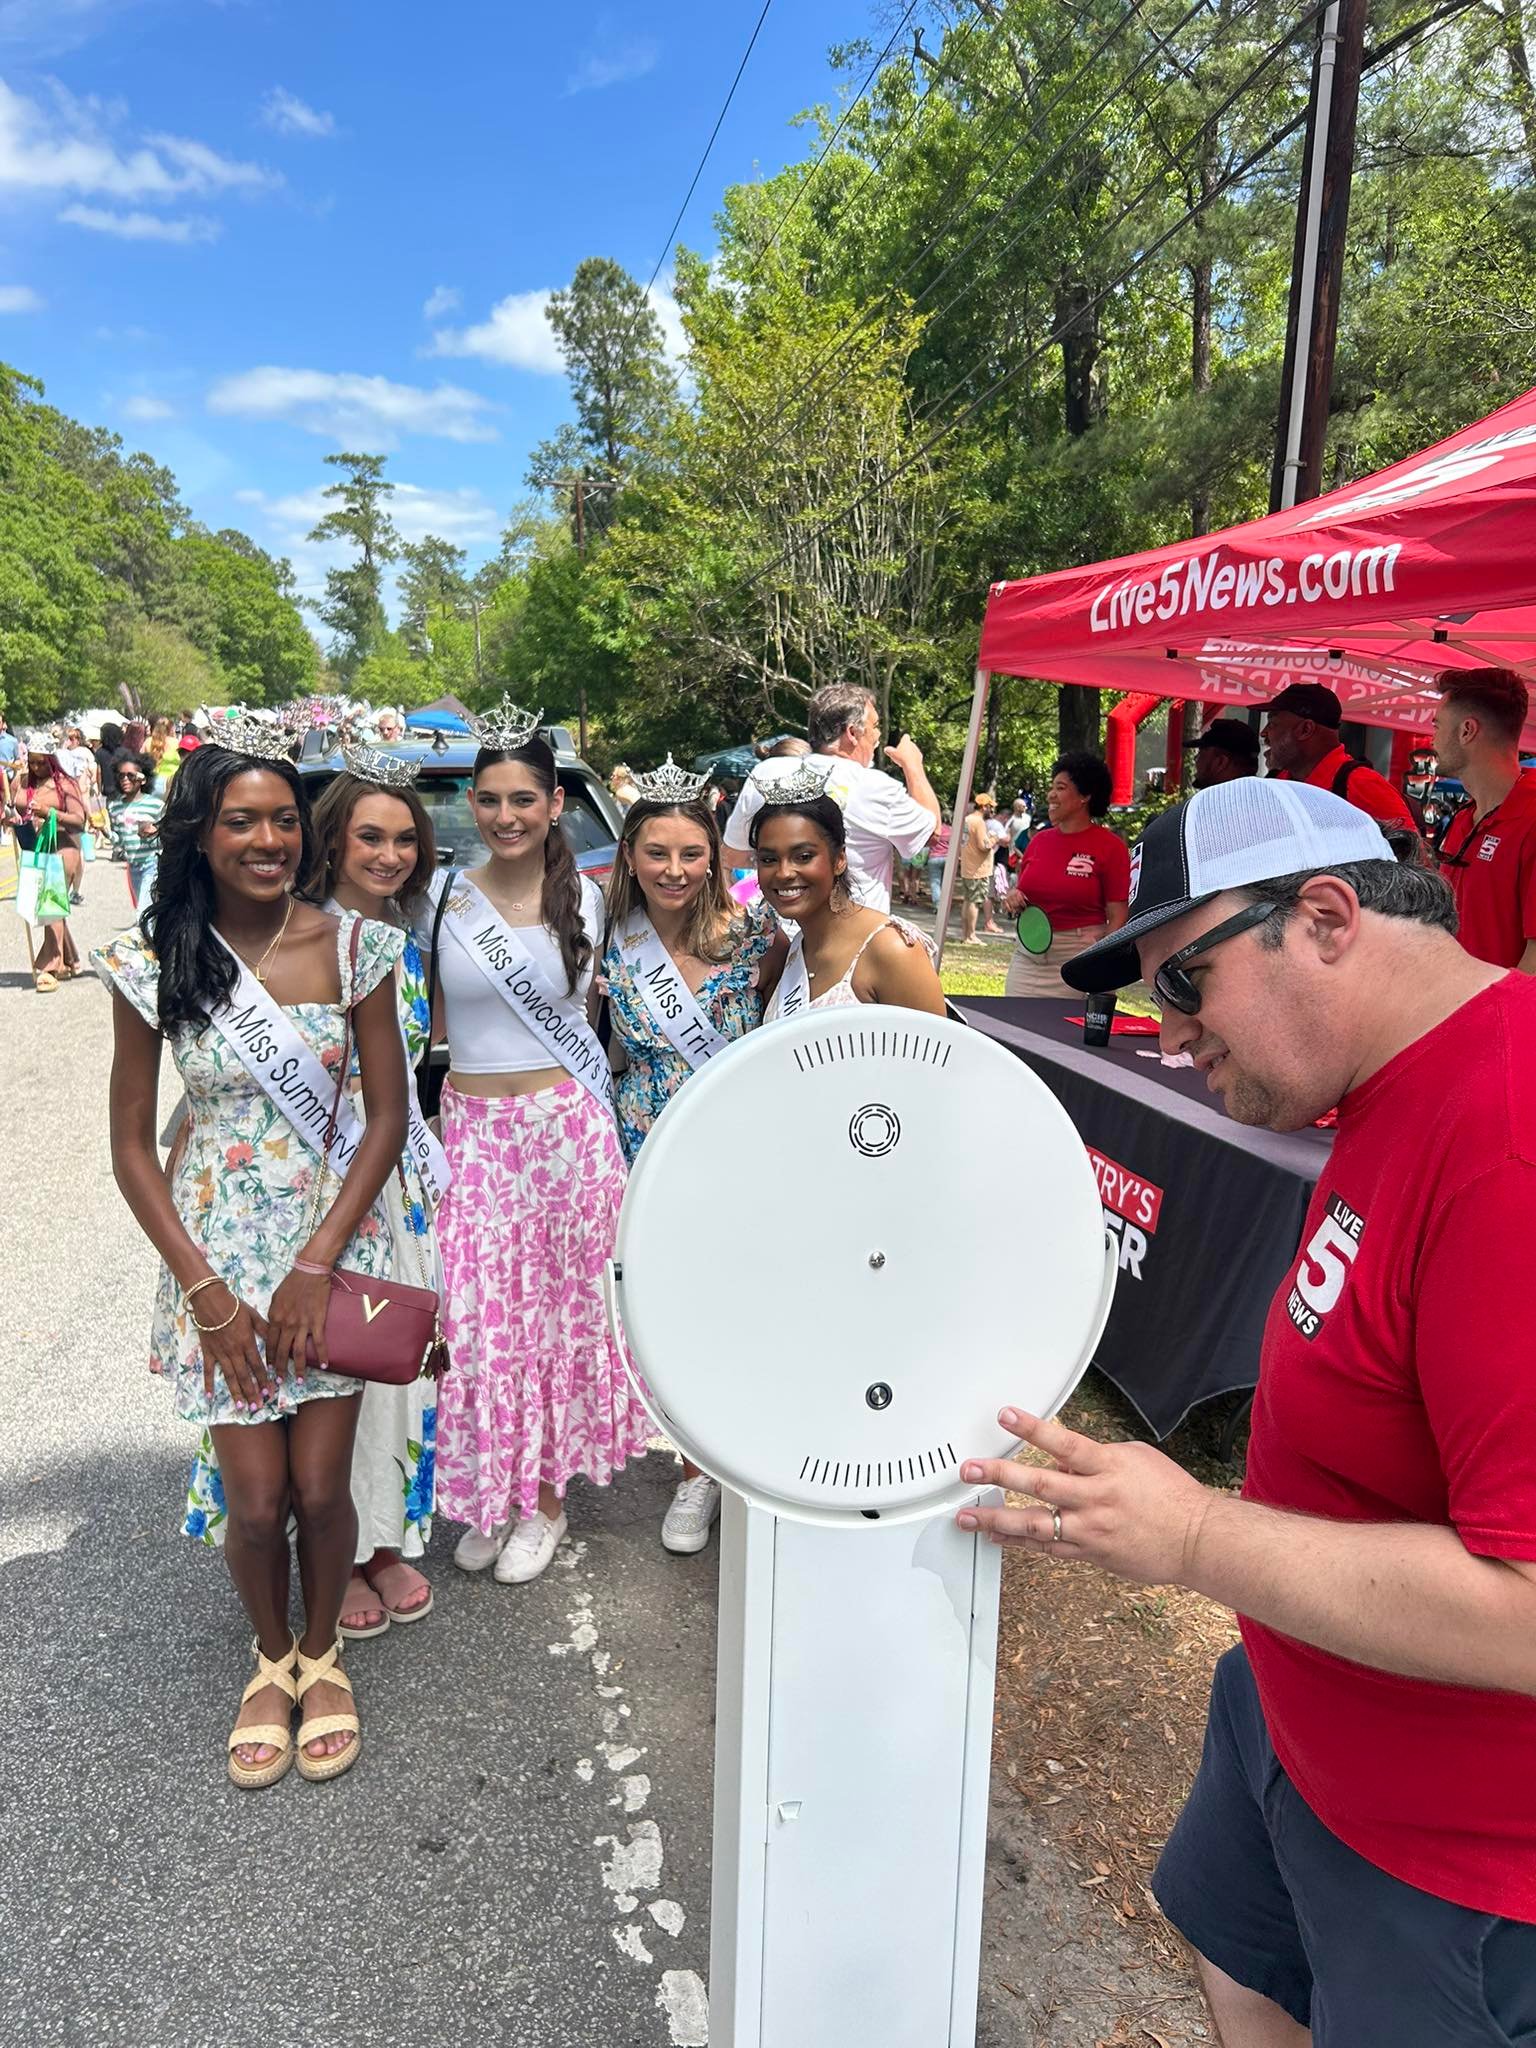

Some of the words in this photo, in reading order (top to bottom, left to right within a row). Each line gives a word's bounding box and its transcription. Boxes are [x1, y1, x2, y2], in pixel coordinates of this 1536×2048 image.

[1089, 543, 1402, 632] Live5News.com
[1066, 856, 1094, 873] 5
[472, 924, 513, 971] Miss
[505, 965, 600, 1080] Lowcountry's
[645, 963, 683, 1019] Miss
[228, 1004, 279, 1063] Miss
[1333, 1200, 1364, 1239] LIVE
[1296, 1214, 1360, 1314] 5
[1287, 1287, 1319, 1335] NEWS
